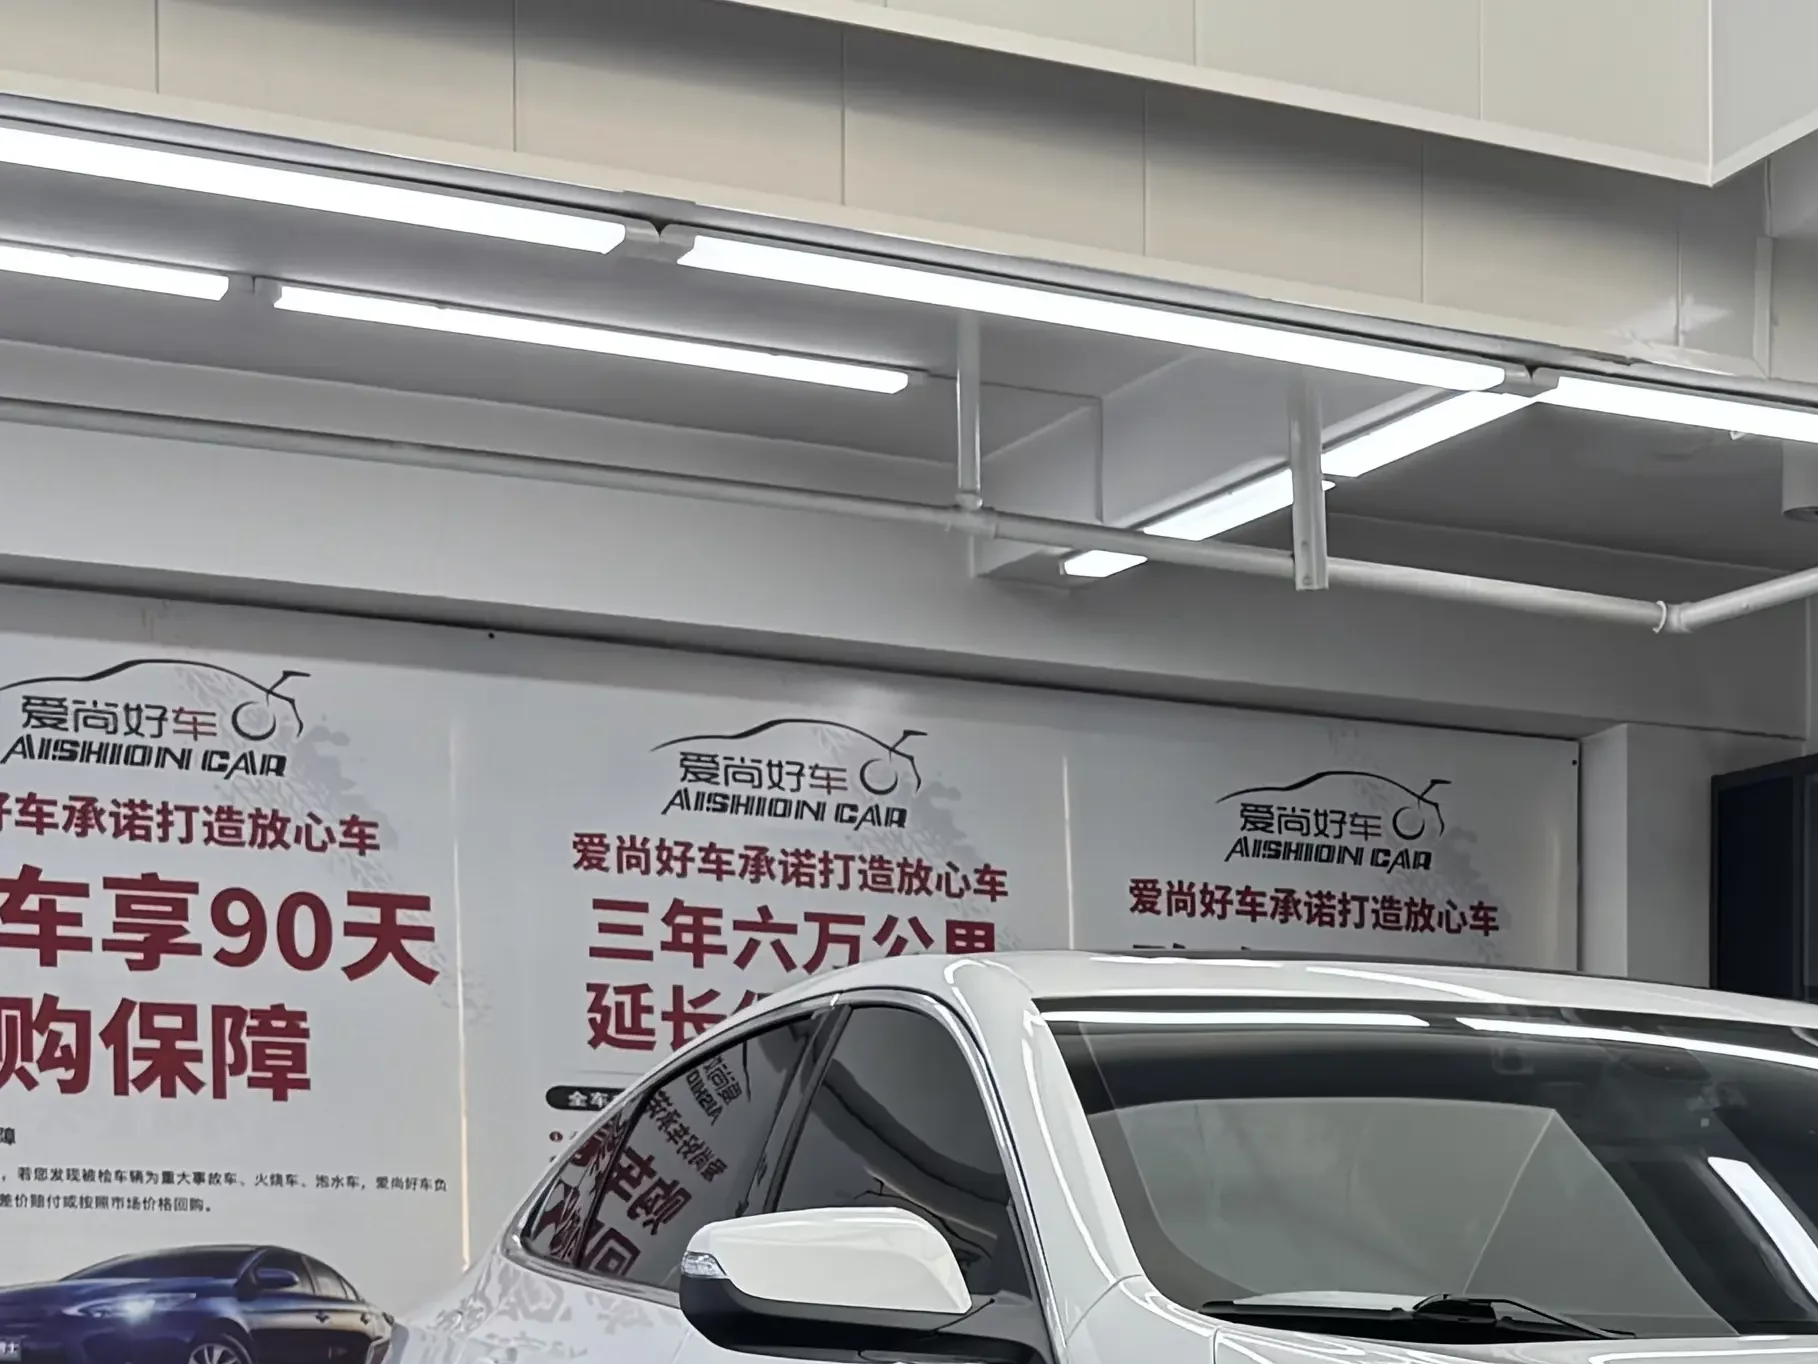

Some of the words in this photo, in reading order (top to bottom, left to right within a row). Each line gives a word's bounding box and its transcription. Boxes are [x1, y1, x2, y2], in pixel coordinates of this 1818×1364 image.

[21, 695, 217, 741] 爱尚好车
[0, 734, 193, 771] AISHION
[201, 749, 287, 780] CAR
[679, 752, 847, 796] 爱尚好车
[0, 792, 380, 857] 车承诺打造放心车
[661, 788, 826, 822] AISHION
[834, 798, 907, 831] CAR
[1239, 803, 1382, 842] 爱尚好车
[572, 832, 1009, 902] 爱尚好车承诺打造放心车
[1224, 836, 1363, 867] AISHION
[1370, 848, 1432, 874] CAR
[0, 864, 440, 985] 车享90天
[1129, 878, 1499, 936] 爱尚好车承诺打造放心车
[586, 982, 773, 1051] 延长
[0, 993, 311, 1102] 购保障
